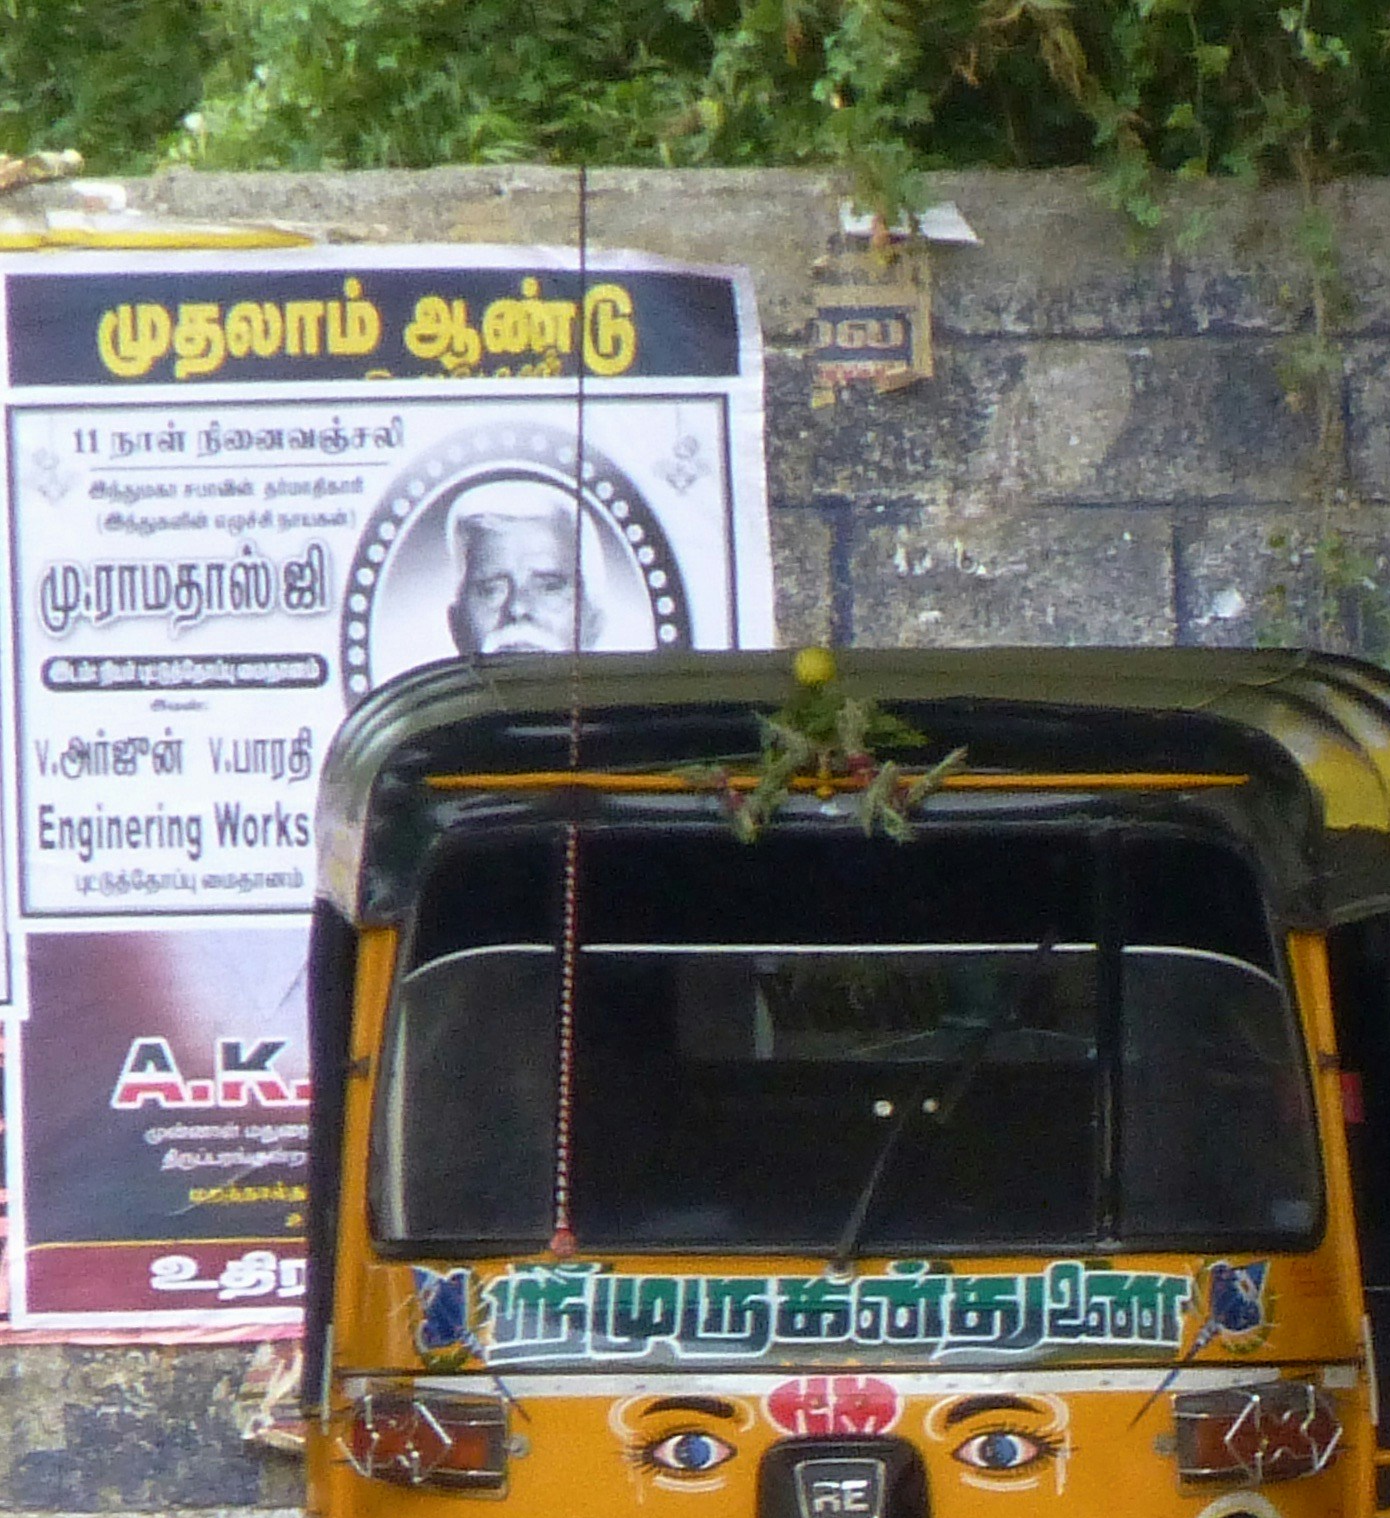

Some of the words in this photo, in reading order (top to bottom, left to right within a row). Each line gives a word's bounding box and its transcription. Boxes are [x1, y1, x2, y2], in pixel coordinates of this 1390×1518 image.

[98, 278, 381, 380] முதலாம்
[403, 278, 638, 377] ஆண்டு
[73, 427, 99, 454] 11
[39, 802, 202, 862] Enginering
[214, 801, 311, 848] Works
[812, 1480, 870, 1512] RE
